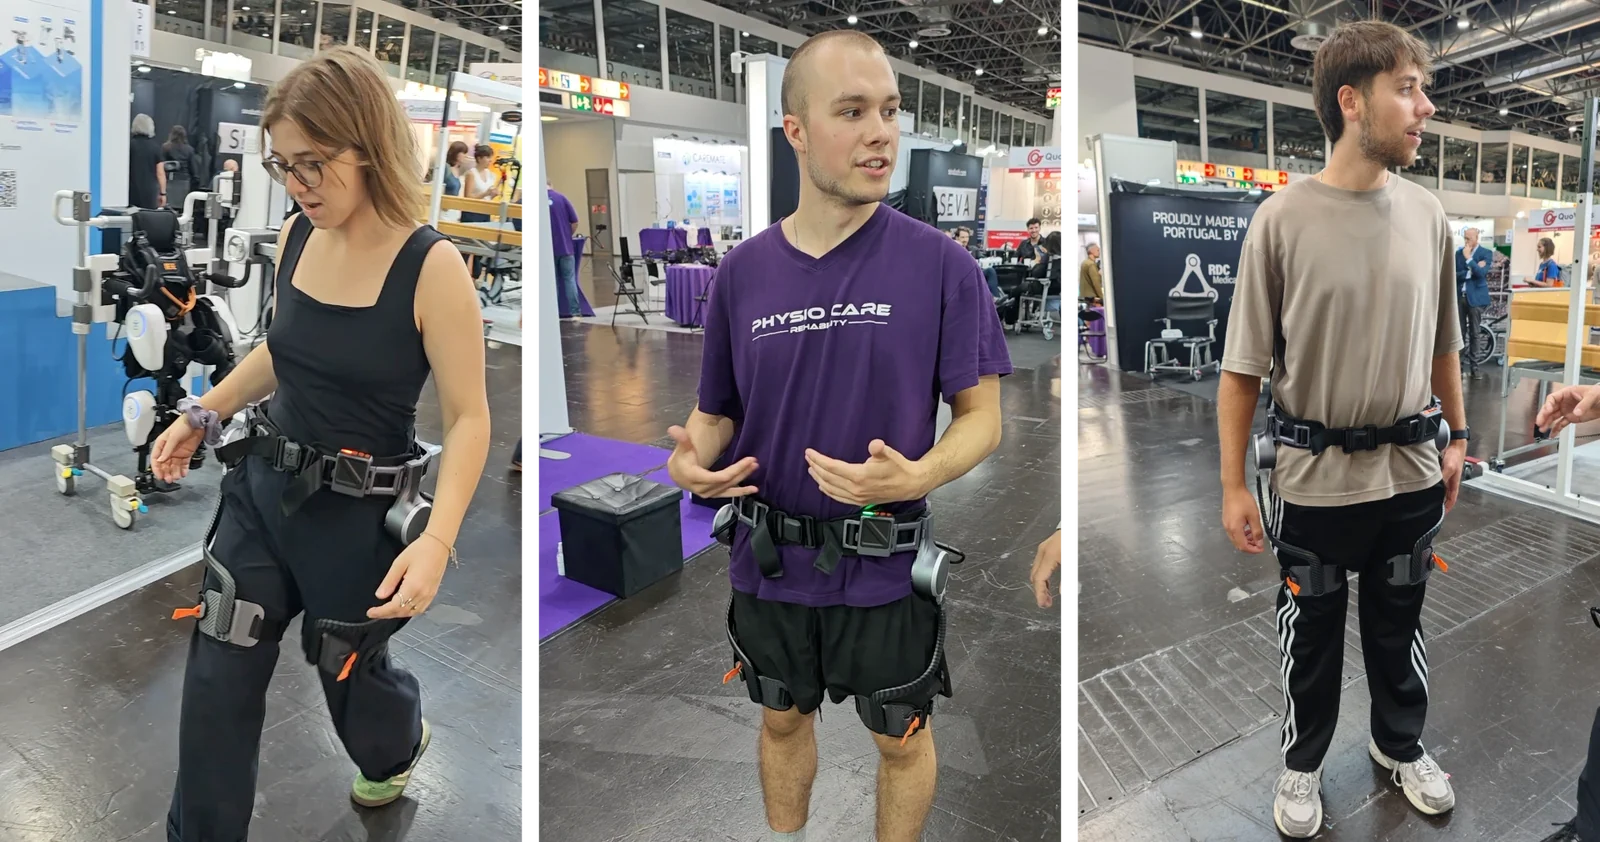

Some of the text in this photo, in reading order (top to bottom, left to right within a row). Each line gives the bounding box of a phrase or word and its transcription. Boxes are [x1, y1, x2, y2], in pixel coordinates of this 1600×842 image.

[939, 193, 970, 216] SEVA
[1153, 211, 1248, 229] PROUDLY MADE IN
[1163, 226, 1239, 241] PORTUGAL BY
[1208, 264, 1231, 276] RDC
[752, 302, 892, 333] PHYSIO CARE
